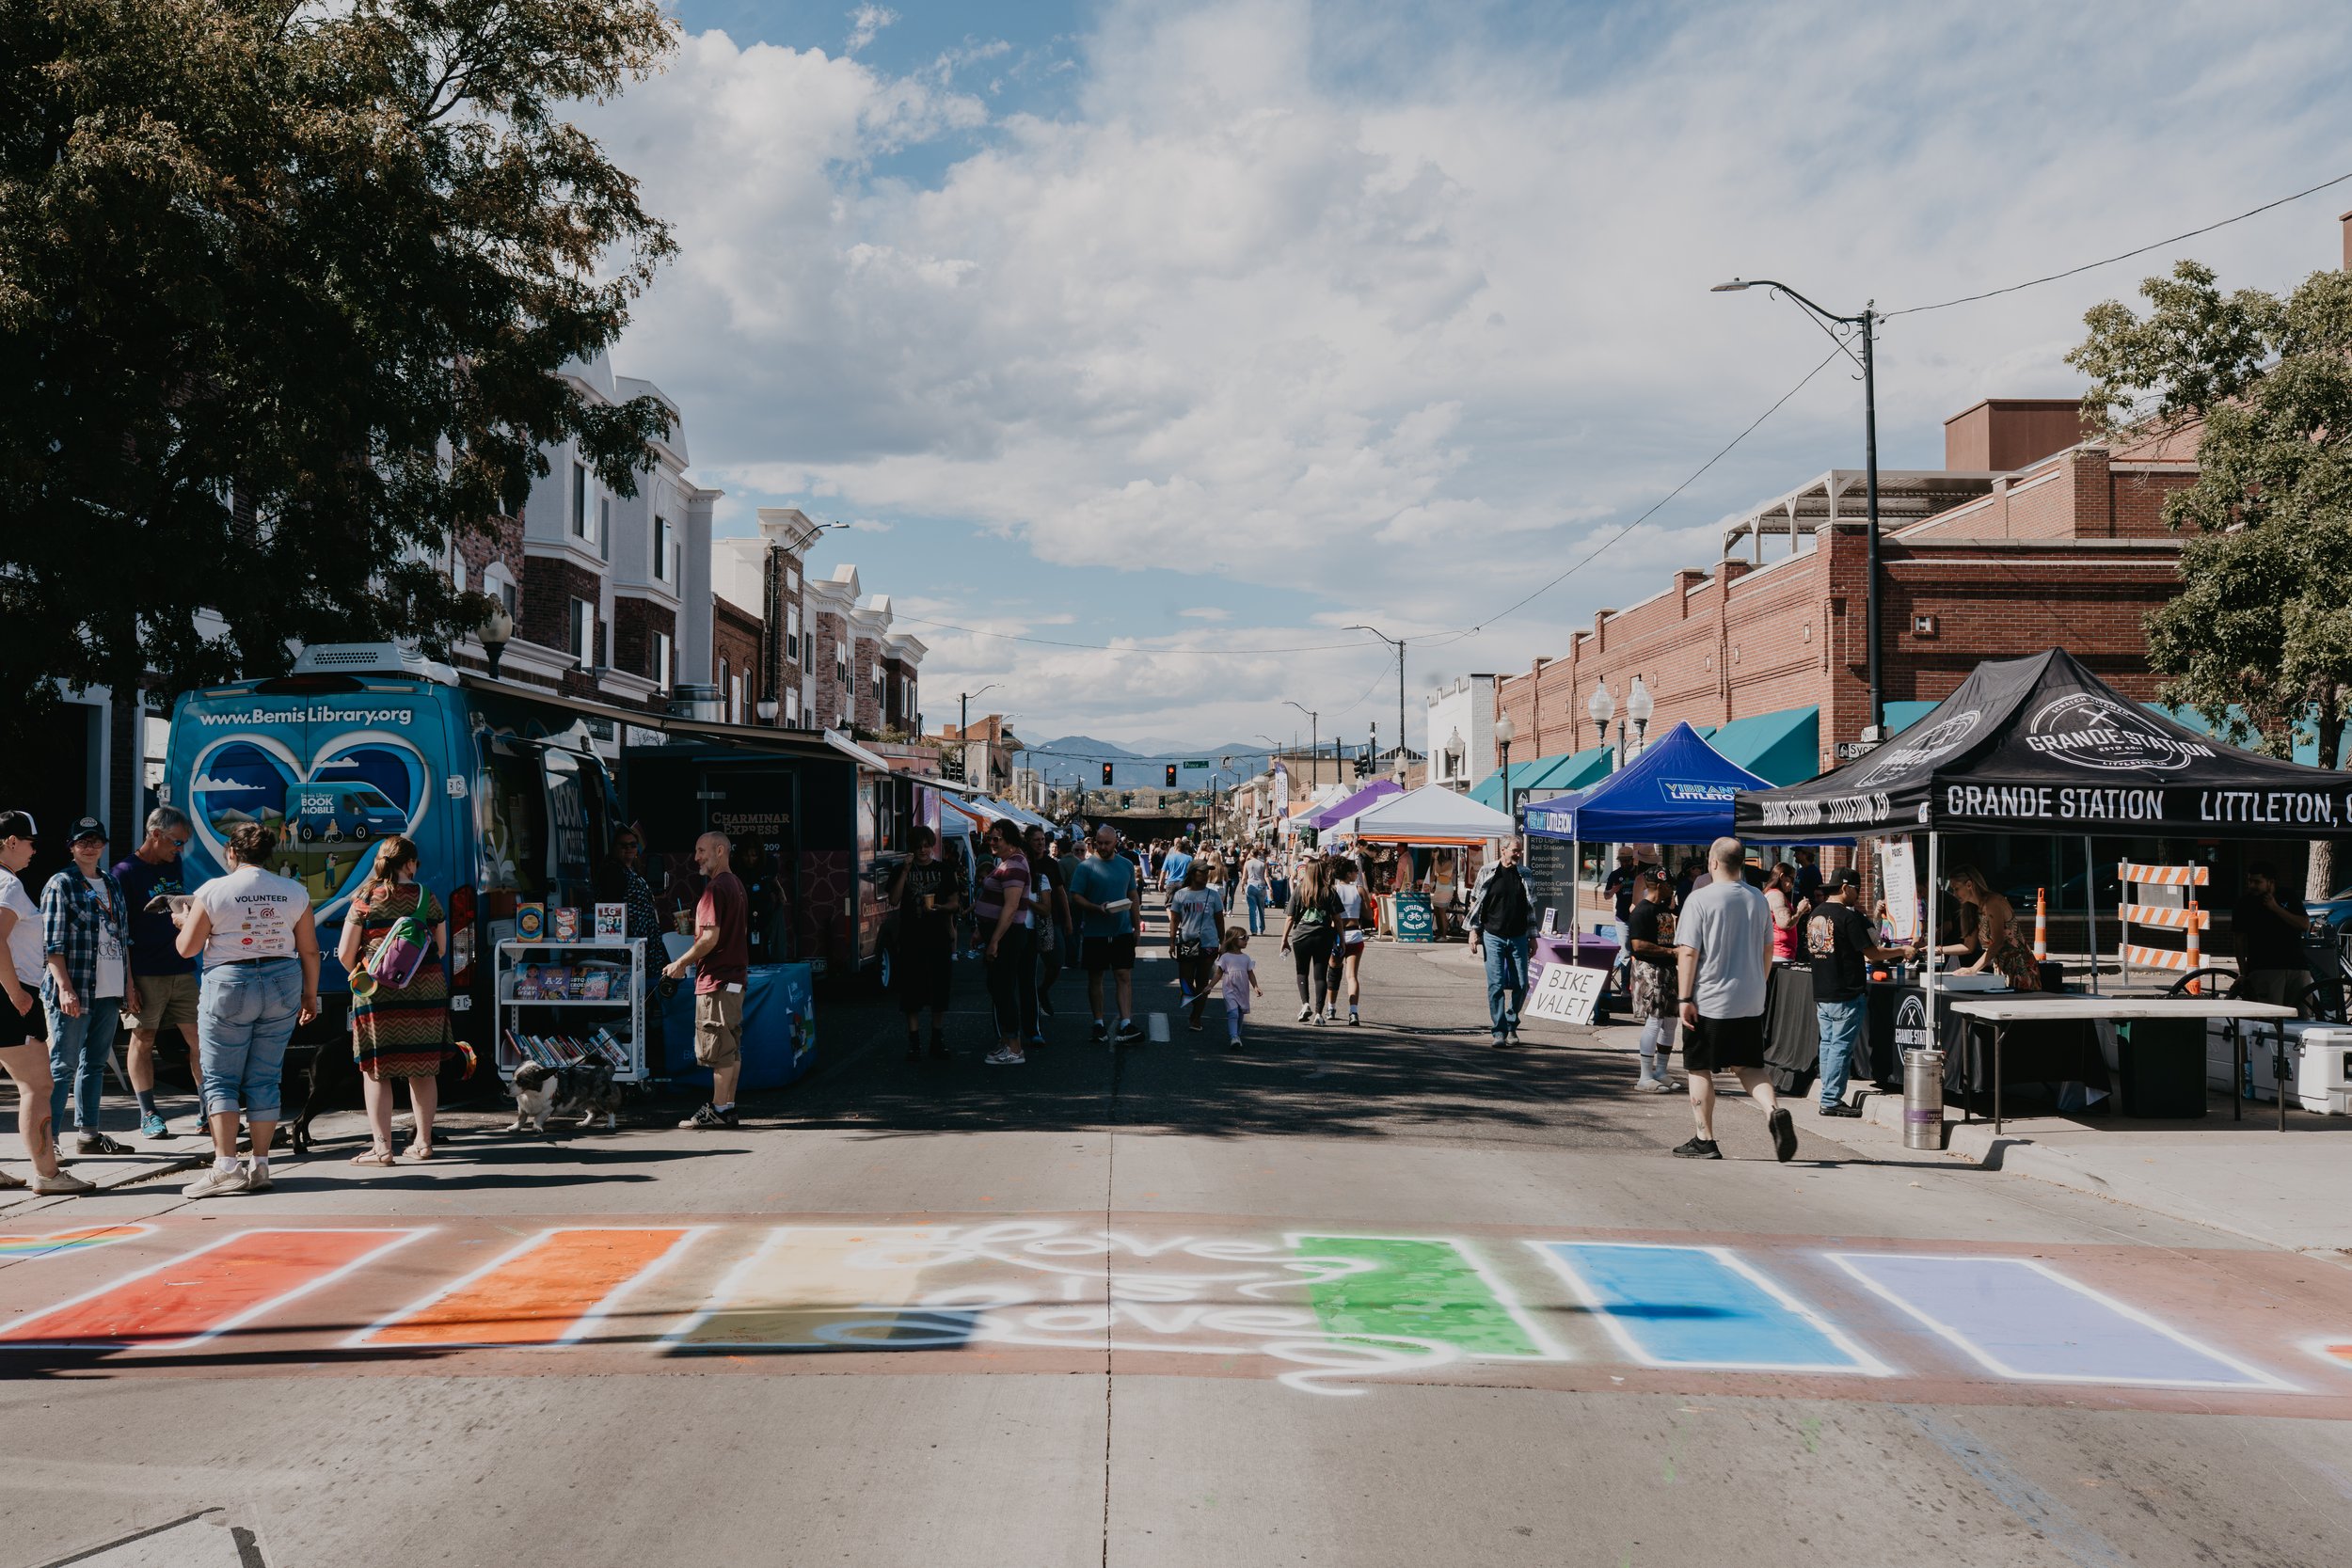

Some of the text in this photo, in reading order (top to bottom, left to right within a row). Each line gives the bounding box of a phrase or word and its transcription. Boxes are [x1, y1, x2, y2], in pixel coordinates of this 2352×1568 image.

[199, 705, 412, 725] www.BemisLibrary.org
[2051, 696, 2088, 714] SCRATCH
[2025, 728, 2217, 758] GRANDE STATION
[1664, 783, 1742, 795] VIBRANT
[1670, 792, 1735, 800] LITTLETO
[300, 798, 333, 806] BOOK
[301, 805, 335, 815] MOBILE
[552, 784, 582, 828] BOOK
[1761, 800, 1821, 826] GRANDE STATION
[1828, 795, 1873, 826] LITTLETON,
[1874, 792, 1890, 821] CO
[1947, 785, 2053, 816] GRANDE
[2060, 787, 2164, 819] STATION
[2201, 791, 2338, 828] LITTLETON,
[1527, 810, 1573, 834] VIBRANT LITTLETON
[559, 829, 585, 863] MOBILE
[234, 895, 288, 903] VOLUNTEER
[602, 907, 616, 916] LG
[607, 915, 622, 926] BT
[1549, 969, 1594, 993] BIKE
[1536, 992, 1589, 1017] VALET
[1895, 1028, 1914, 1044] GRANDE
